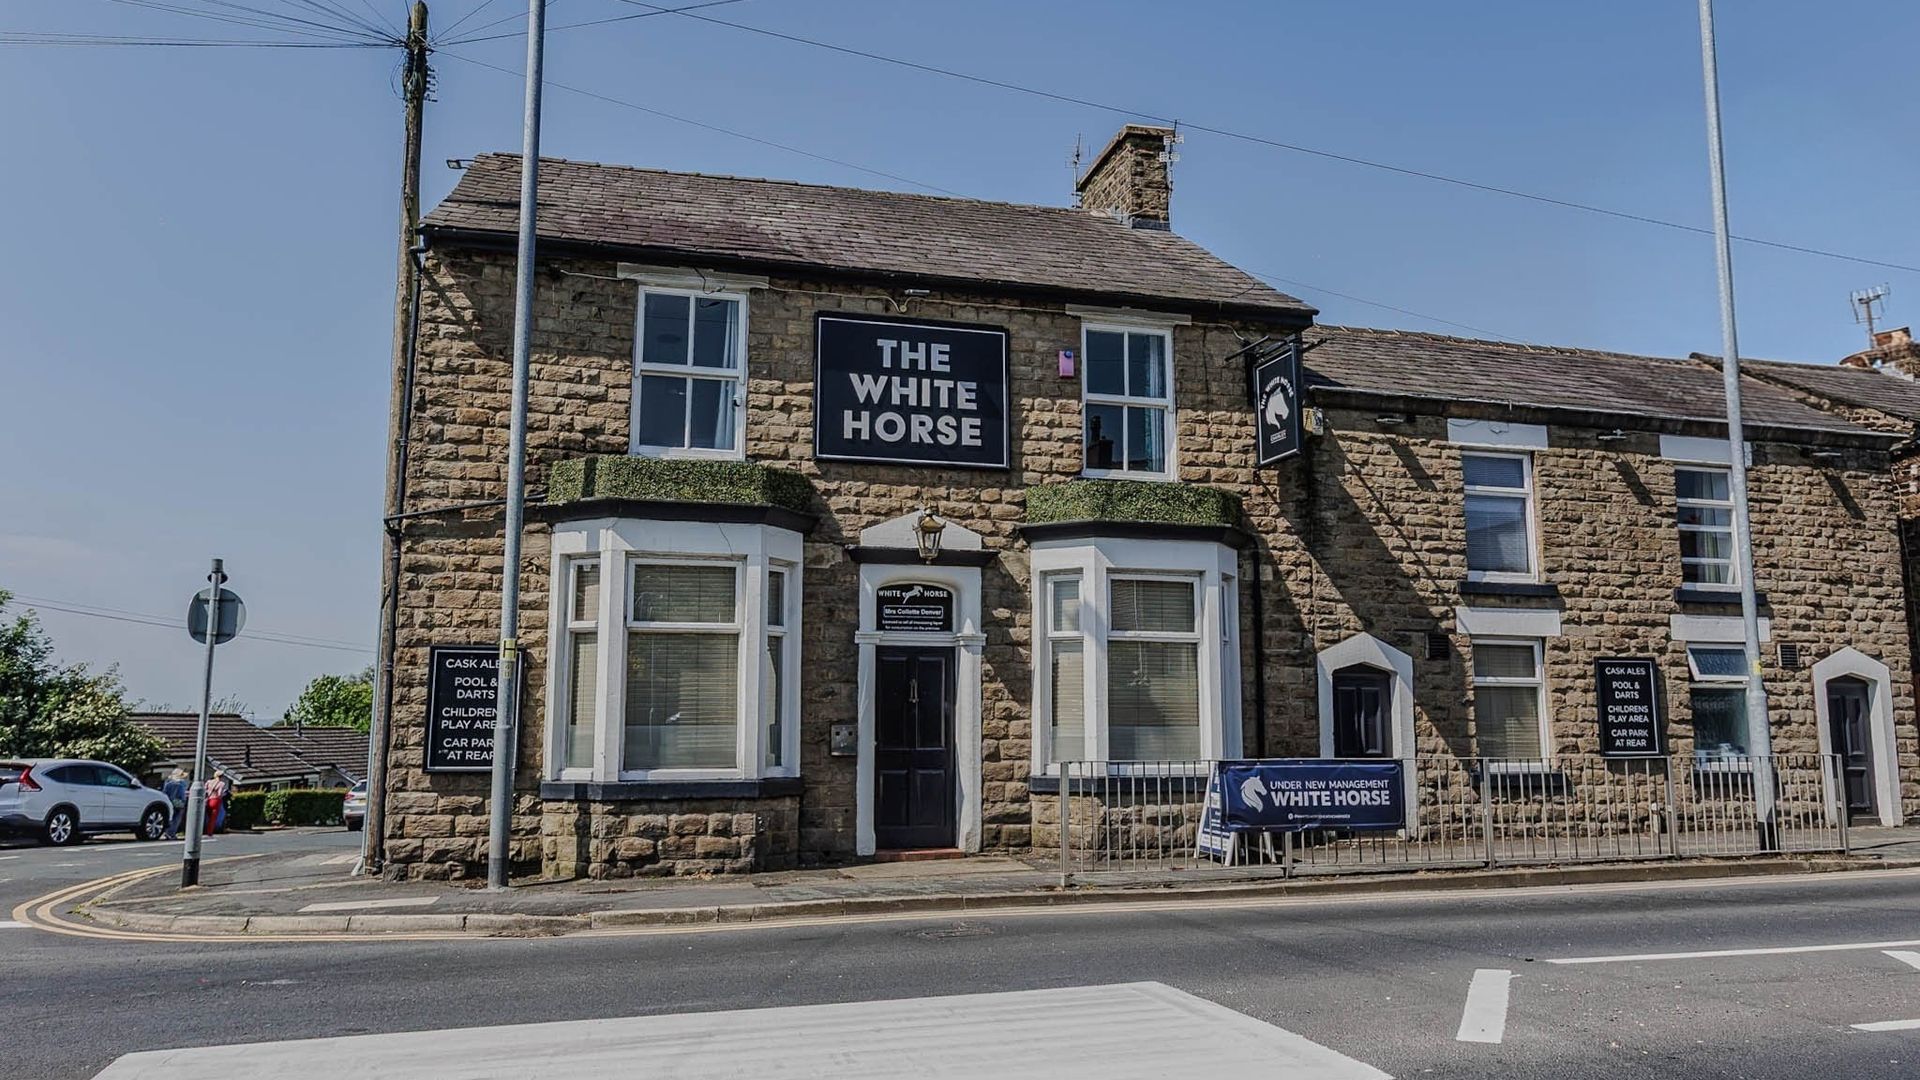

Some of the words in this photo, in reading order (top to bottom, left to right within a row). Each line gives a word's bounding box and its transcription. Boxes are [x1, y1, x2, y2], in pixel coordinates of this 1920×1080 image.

[877, 338, 950, 372] THE
[849, 373, 977, 410] WHITE
[1265, 376, 1280, 392] WHITE
[1280, 376, 1294, 398] HORSE
[843, 410, 982, 447] HORSE
[878, 590, 901, 598] WHITE
[924, 590, 948, 598] HORSE
[503, 639, 517, 658] H
[446, 659, 478, 669] CASK
[480, 659, 500, 669] ALE
[1605, 667, 1626, 675] CASK
[1627, 667, 1646, 675] ALES
[454, 677, 487, 687] POOL
[490, 677, 498, 687] &
[1612, 681, 1633, 689] POOL
[1634, 681, 1640, 689] &
[456, 690, 496, 700] DARTS
[1615, 691, 1640, 699] DARTS
[442, 707, 498, 717] CHILDREN
[1607, 705, 1649, 713] CHILDRENS
[1608, 715, 1627, 723] PLAY
[1628, 715, 1649, 723] AREA
[441, 720, 471, 729] PLAY
[473, 720, 497, 729] ARE
[1611, 729, 1627, 737] CAR
[1629, 729, 1648, 737] PARK
[443, 738, 468, 748] CAR
[471, 738, 495, 748] PAR
[1615, 739, 1625, 747] AT
[1626, 739, 1647, 747] REAR
[447, 750, 462, 760] AT
[1270, 780, 1302, 789] UNDER
[1305, 780, 1326, 789] NEW
[1329, 779, 1389, 789] MANAGEMENT
[1271, 790, 1331, 807] WHITE
[1334, 790, 1391, 806] HORSE
